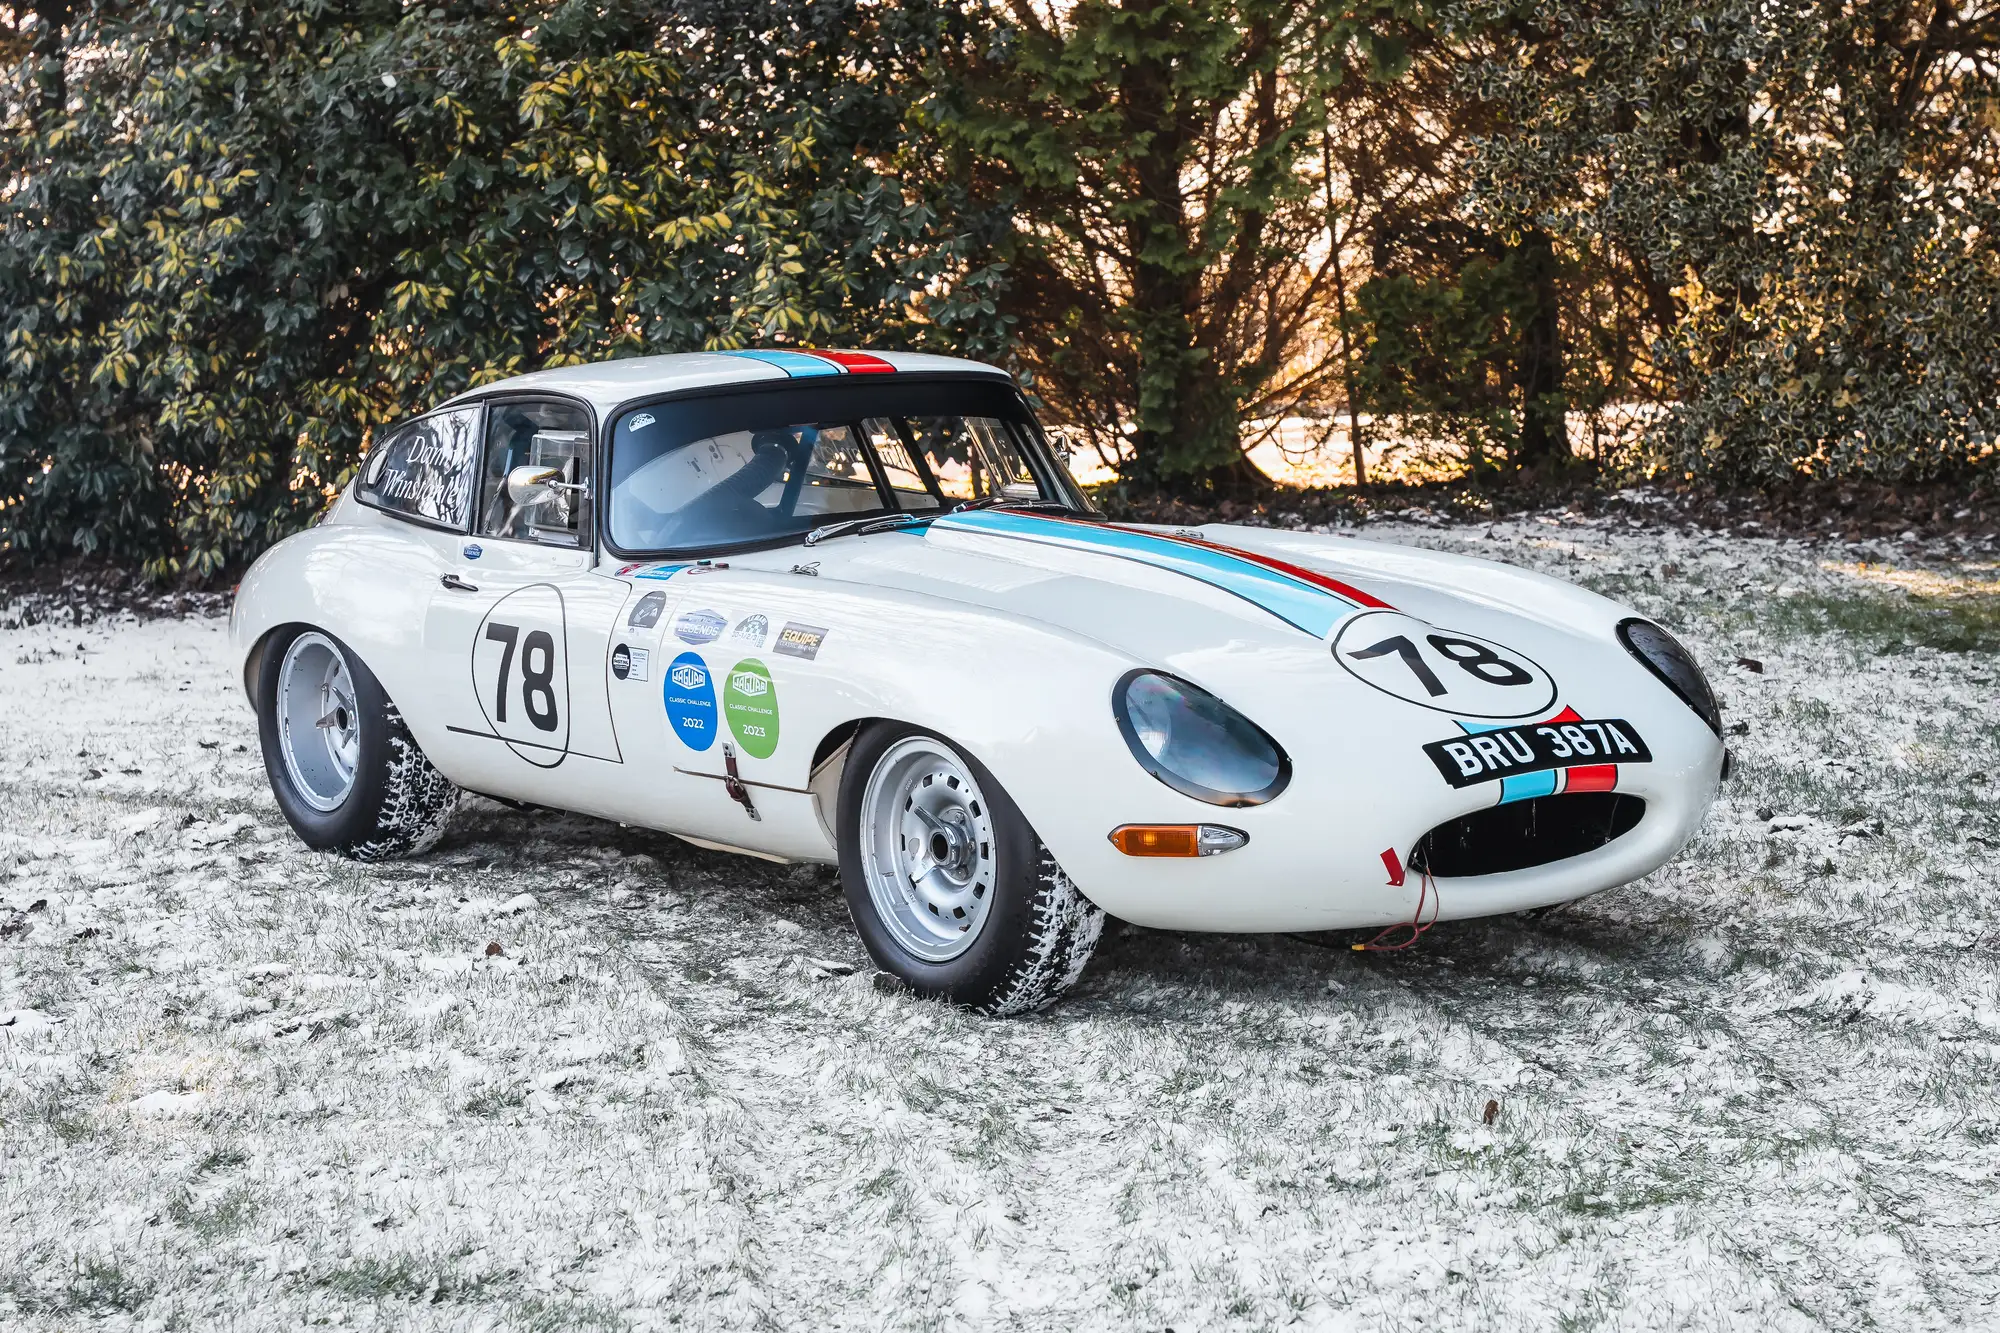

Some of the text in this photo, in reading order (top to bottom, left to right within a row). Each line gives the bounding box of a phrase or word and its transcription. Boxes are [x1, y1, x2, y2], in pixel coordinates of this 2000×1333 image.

[405, 435, 462, 475] Danny
[382, 468, 469, 513] Winstanley
[677, 623, 720, 637] LEGENDS
[782, 628, 821, 647] EQUIPE
[1346, 634, 1534, 697] 78
[485, 622, 558, 733] 78
[672, 667, 704, 687] JAGUAR
[734, 673, 766, 695] JAGUAR
[669, 696, 712, 708] CLASSIC CHALLENGE
[729, 703, 773, 716] CLASSIC CHALLENGE
[682, 716, 705, 730] 2022
[742, 724, 766, 738] 2023
[1442, 722, 1639, 777] BRU 387A
